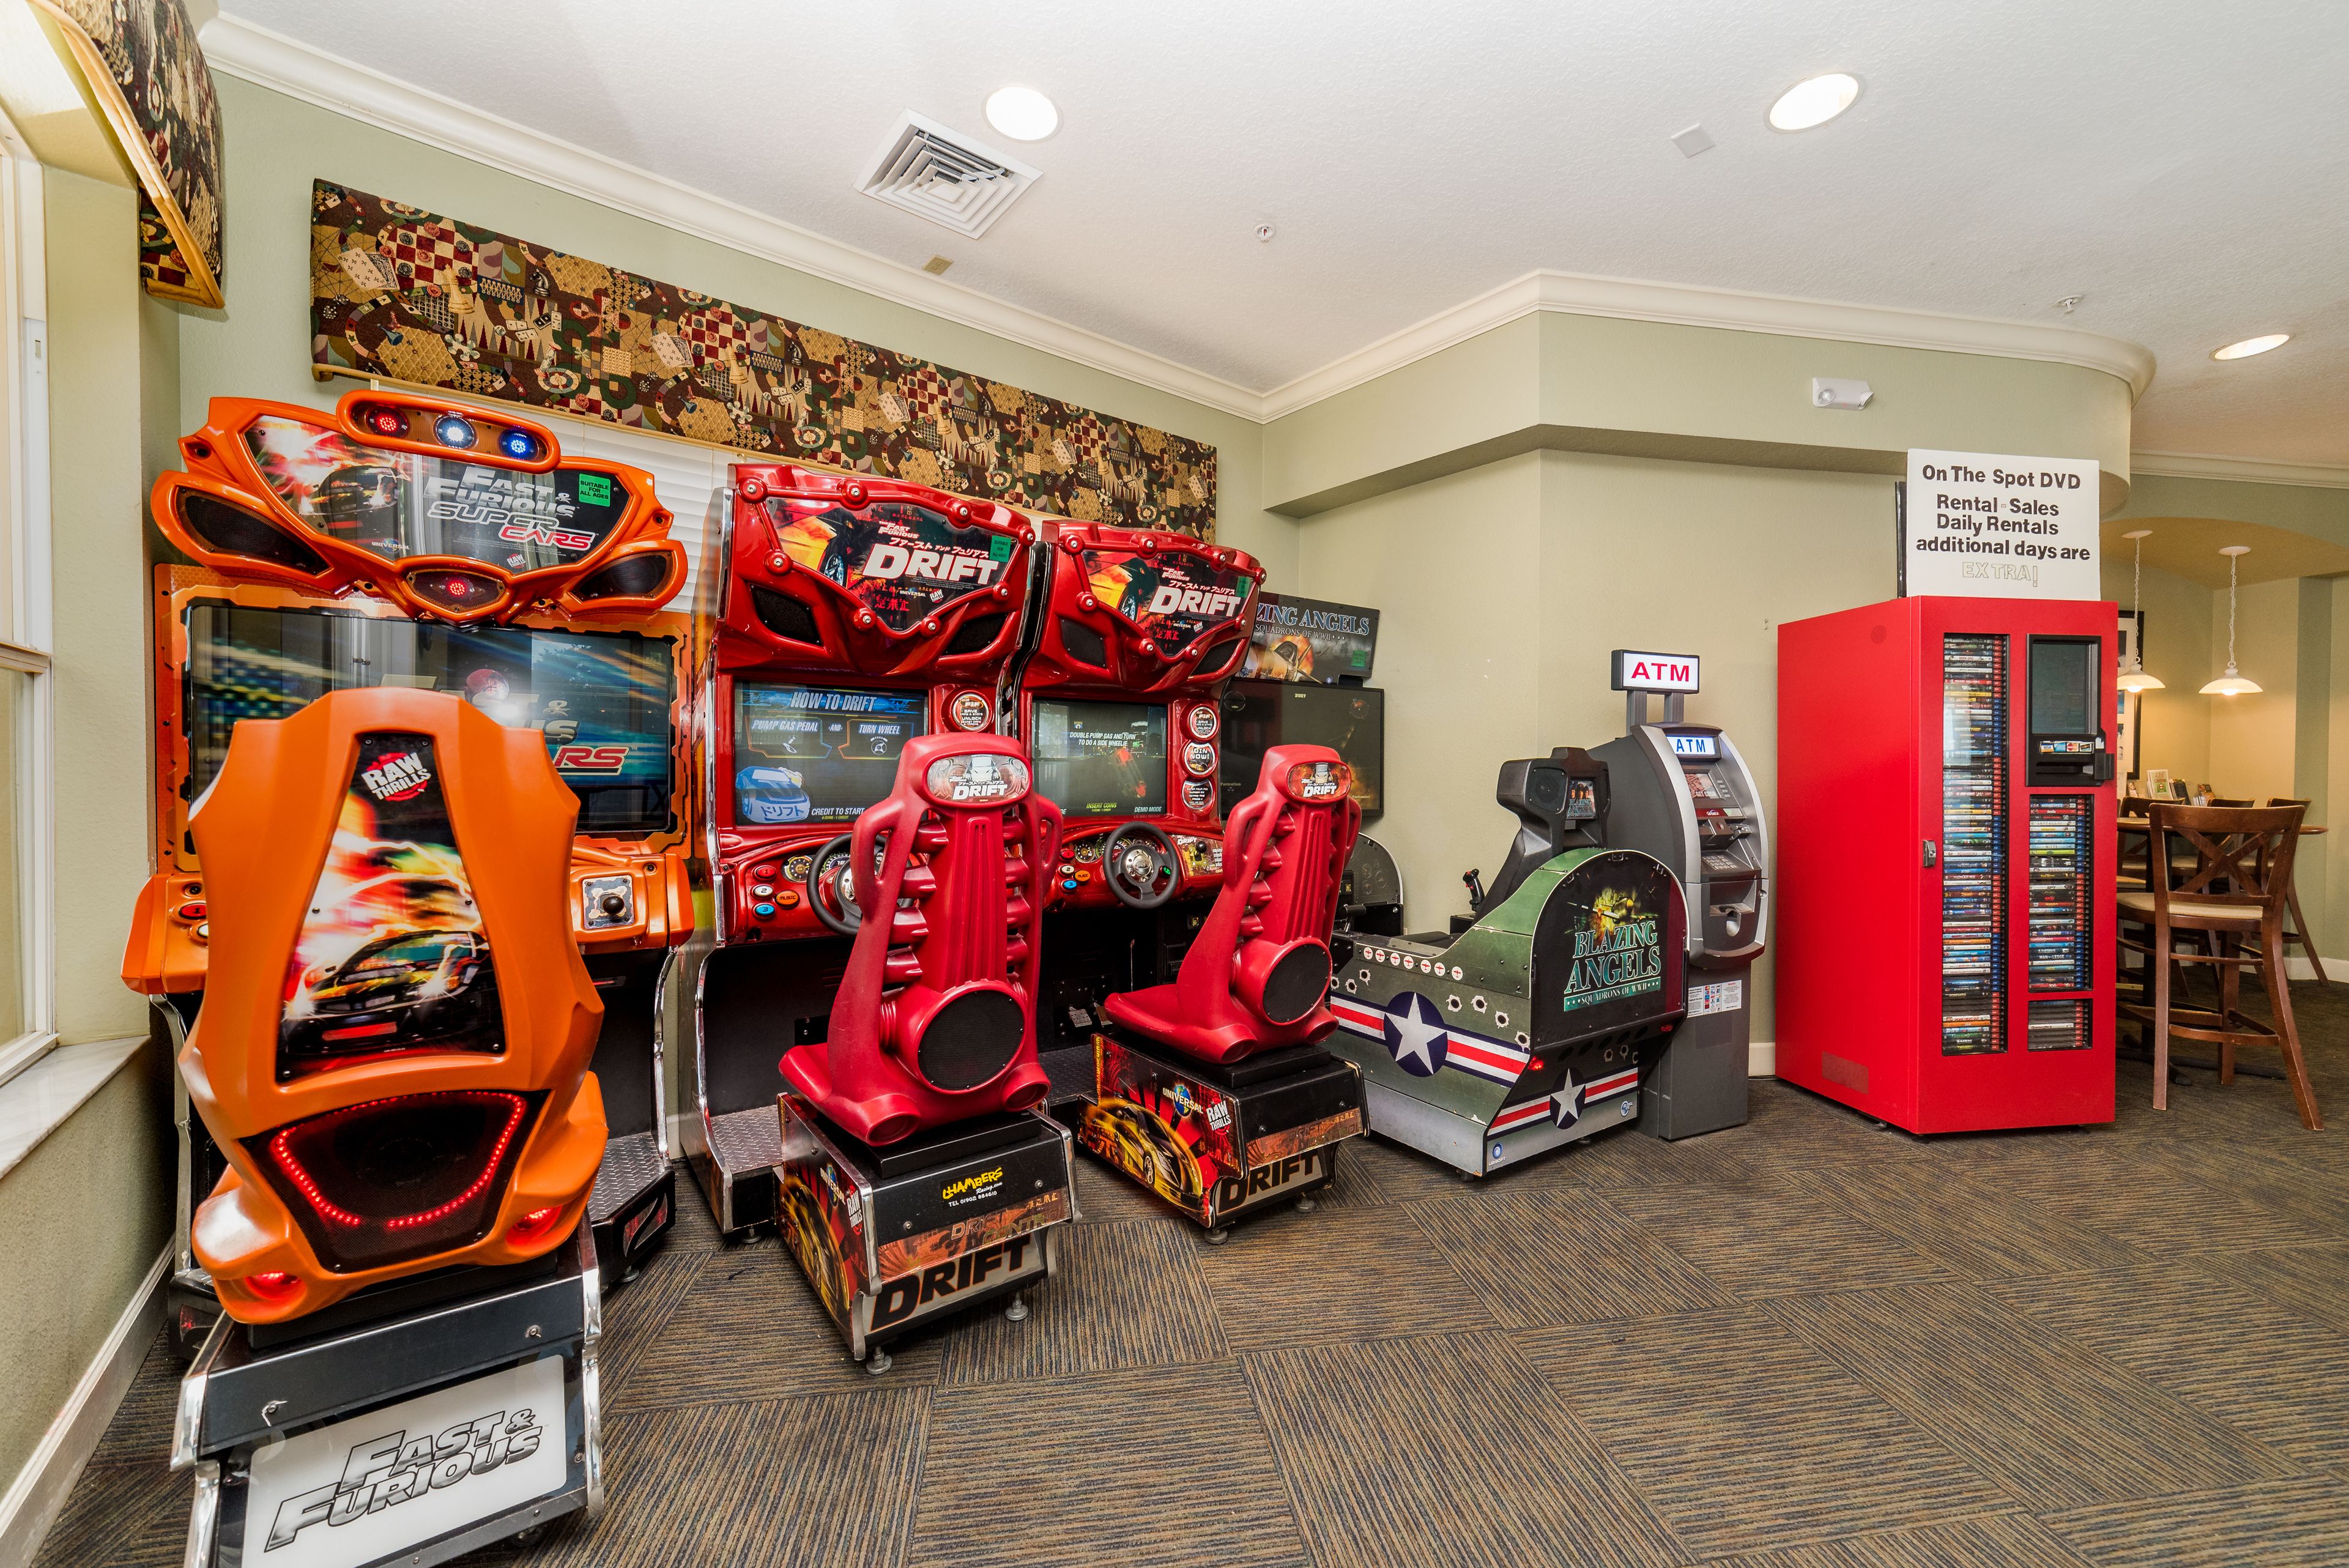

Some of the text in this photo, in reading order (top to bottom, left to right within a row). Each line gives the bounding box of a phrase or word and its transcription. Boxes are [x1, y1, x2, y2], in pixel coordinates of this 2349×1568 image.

[460, 466, 573, 504] FAST &
[580, 480, 609, 491] SUITABLE
[1923, 464, 2080, 489] On The Spot DVD
[423, 477, 576, 518] FURIOUS
[1937, 494, 1998, 513] Rental
[2009, 498, 2059, 516] Sales
[427, 500, 563, 531] SUPER
[887, 522, 910, 531] FAST
[1937, 513, 2059, 537] Daily Rentals
[499, 525, 595, 551] CARS
[878, 526, 919, 539] FURIOUS
[371, 541, 410, 551] UNIVERSAL
[1916, 537, 2091, 560] additional days are
[507, 554, 524, 565] RAW
[862, 543, 999, 585] DRIFT
[1162, 572, 1190, 581] FURIOUS
[1962, 562, 2038, 587] EXTRA!
[930, 589, 943, 599] RAW
[1148, 585, 1242, 617] DRIFT
[1256, 603, 1370, 636] ZING ANGELS
[1255, 624, 1300, 637] SQUADRONS
[1313, 631, 1331, 641] WWII
[1631, 662, 1689, 682] ATM
[790, 692, 877, 712] HOW TO DRIFT
[752, 720, 818, 732] PUMP GAS PEDAL
[859, 724, 900, 734] TURN WHEEL
[1676, 738, 1705, 752] ATM
[361, 752, 423, 790] RAW
[371, 768, 432, 800] THRILLS
[952, 784, 1008, 800] DRIFT
[1303, 786, 1337, 797] DRIFT
[760, 805, 805, 817] ドリフト
[1573, 920, 1658, 959] BLAZING
[1564, 946, 1661, 994] ANGELS
[1581, 983, 1647, 1005] SQUADRONS OF WWII
[1163, 1088, 1204, 1114] UNIVERSAL
[1206, 1101, 1228, 1122] RAW
[1210, 1115, 1231, 1131] THRILLS
[1488, 1156, 1507, 1166] UBISOFT
[820, 1167, 845, 1205] UNIVERSAL
[943, 1167, 1003, 1200] CHAMBERS
[976, 1181, 1003, 1195] Racing.com
[1218, 1148, 1318, 1213] DRIFT
[847, 1191, 861, 1216] RAW
[960, 1195, 978, 1204] 01902
[978, 1191, 997, 1200] 884610
[870, 1233, 1031, 1332] DRIFT
[339, 1408, 536, 1493] FAST &
[264, 1426, 543, 1553] FURIOUS
